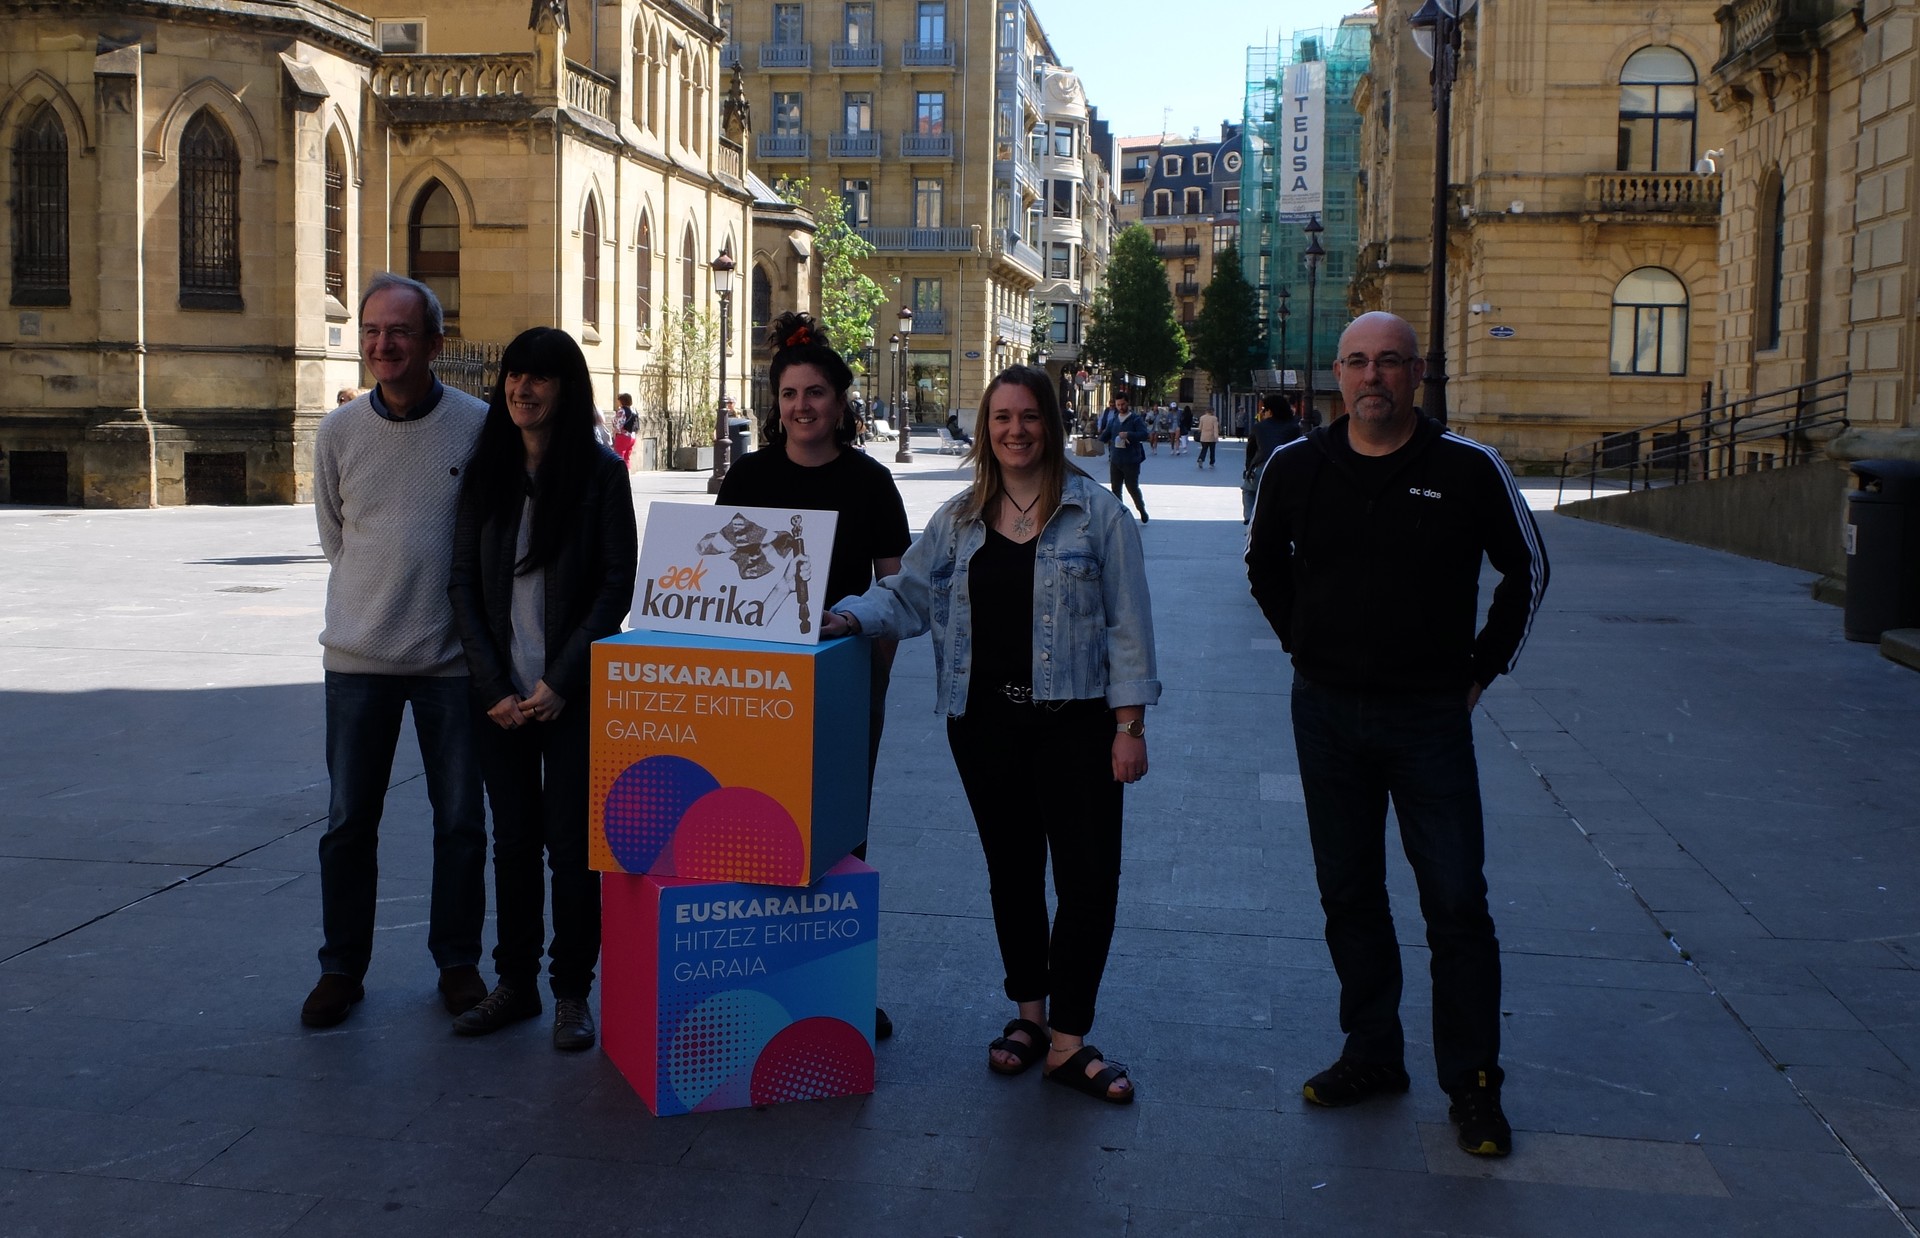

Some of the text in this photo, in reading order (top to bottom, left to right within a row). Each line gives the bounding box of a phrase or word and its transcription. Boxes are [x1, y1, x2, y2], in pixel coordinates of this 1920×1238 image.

[1291, 96, 1308, 192] TEUSA
[658, 559, 708, 591] aek
[641, 578, 764, 627] korrika
[607, 661, 792, 691] EUSKARALDIA
[607, 690, 794, 720] HITZEZ EKITEKO
[605, 719, 698, 744] GARAIA
[675, 891, 858, 923] EUSKARALDIA
[675, 918, 860, 952] HITZEZ EKITEKO
[673, 956, 767, 982] GARAIA
